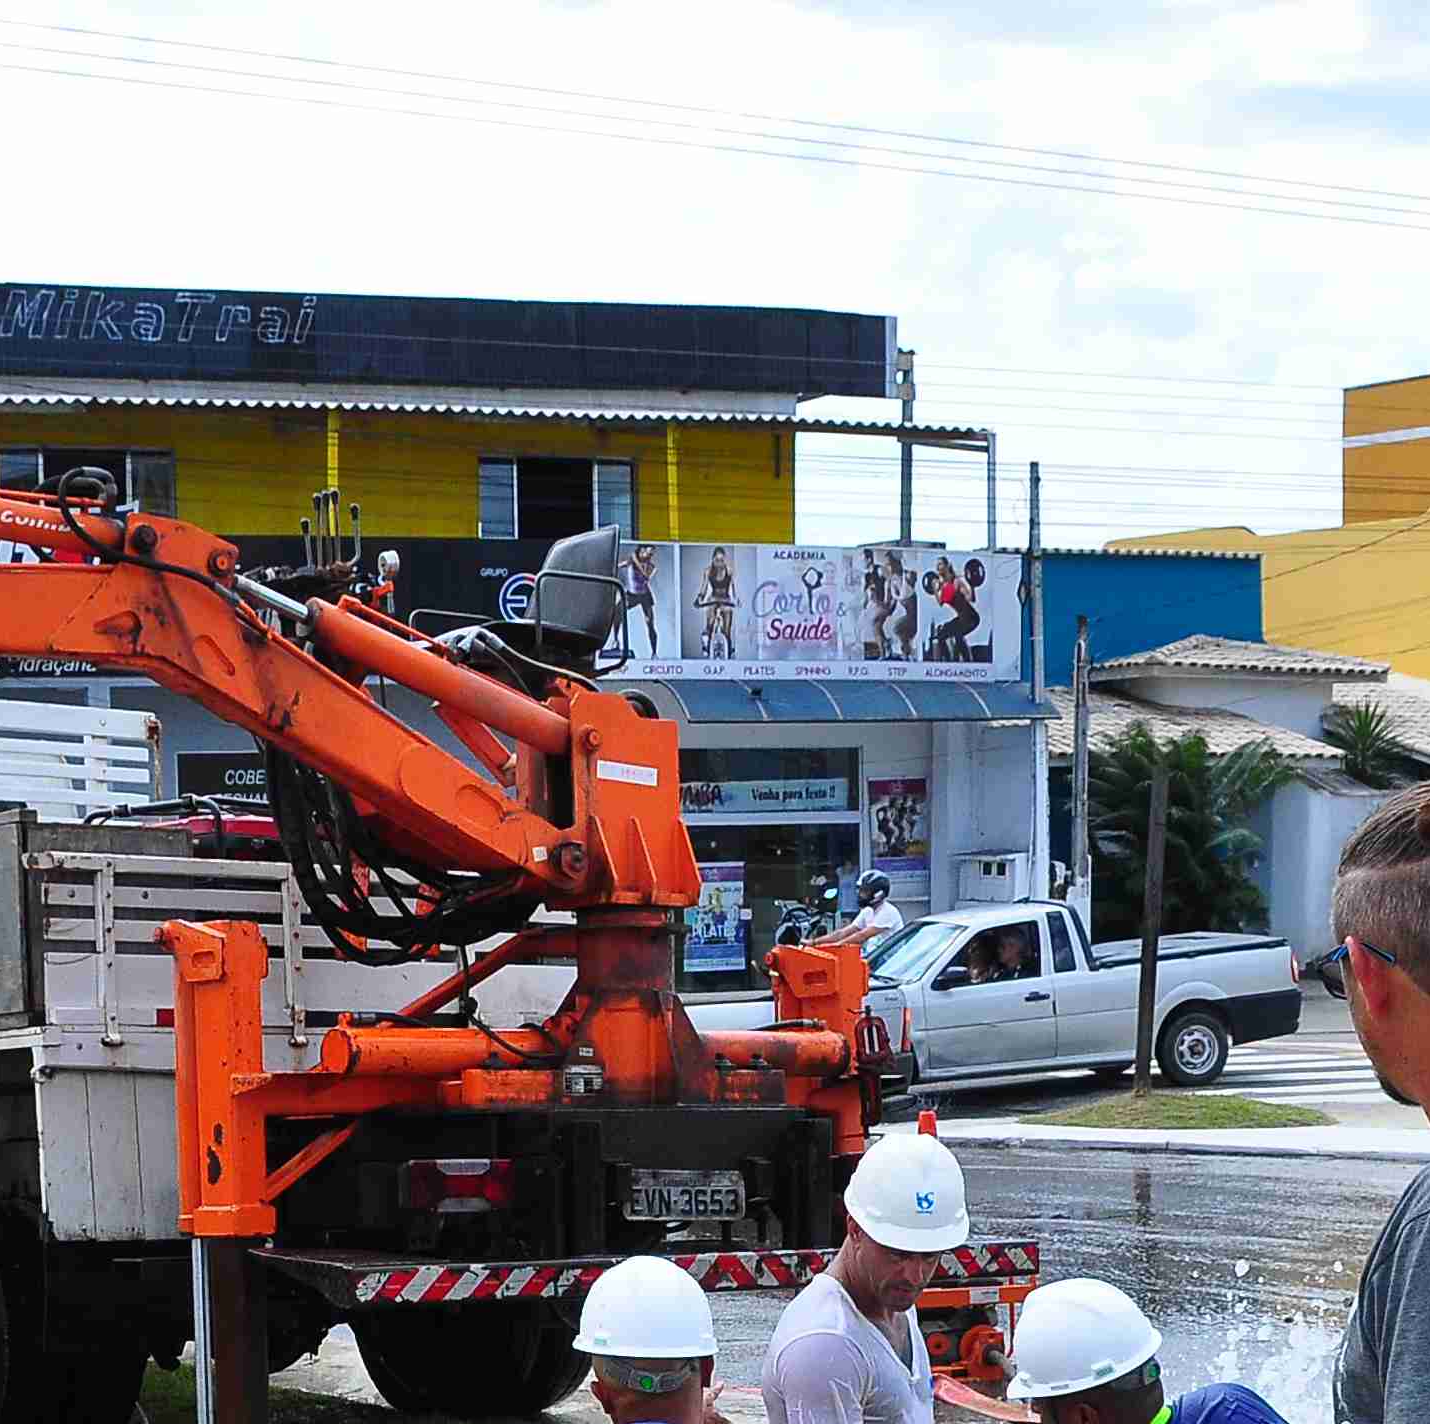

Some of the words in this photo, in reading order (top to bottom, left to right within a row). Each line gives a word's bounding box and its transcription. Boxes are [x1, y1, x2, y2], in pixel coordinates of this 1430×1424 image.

[772, 550, 827, 560] ACADEMIA
[480, 567, 509, 578] GRUPO
[633, 1187, 740, 1216] EVN-3653
